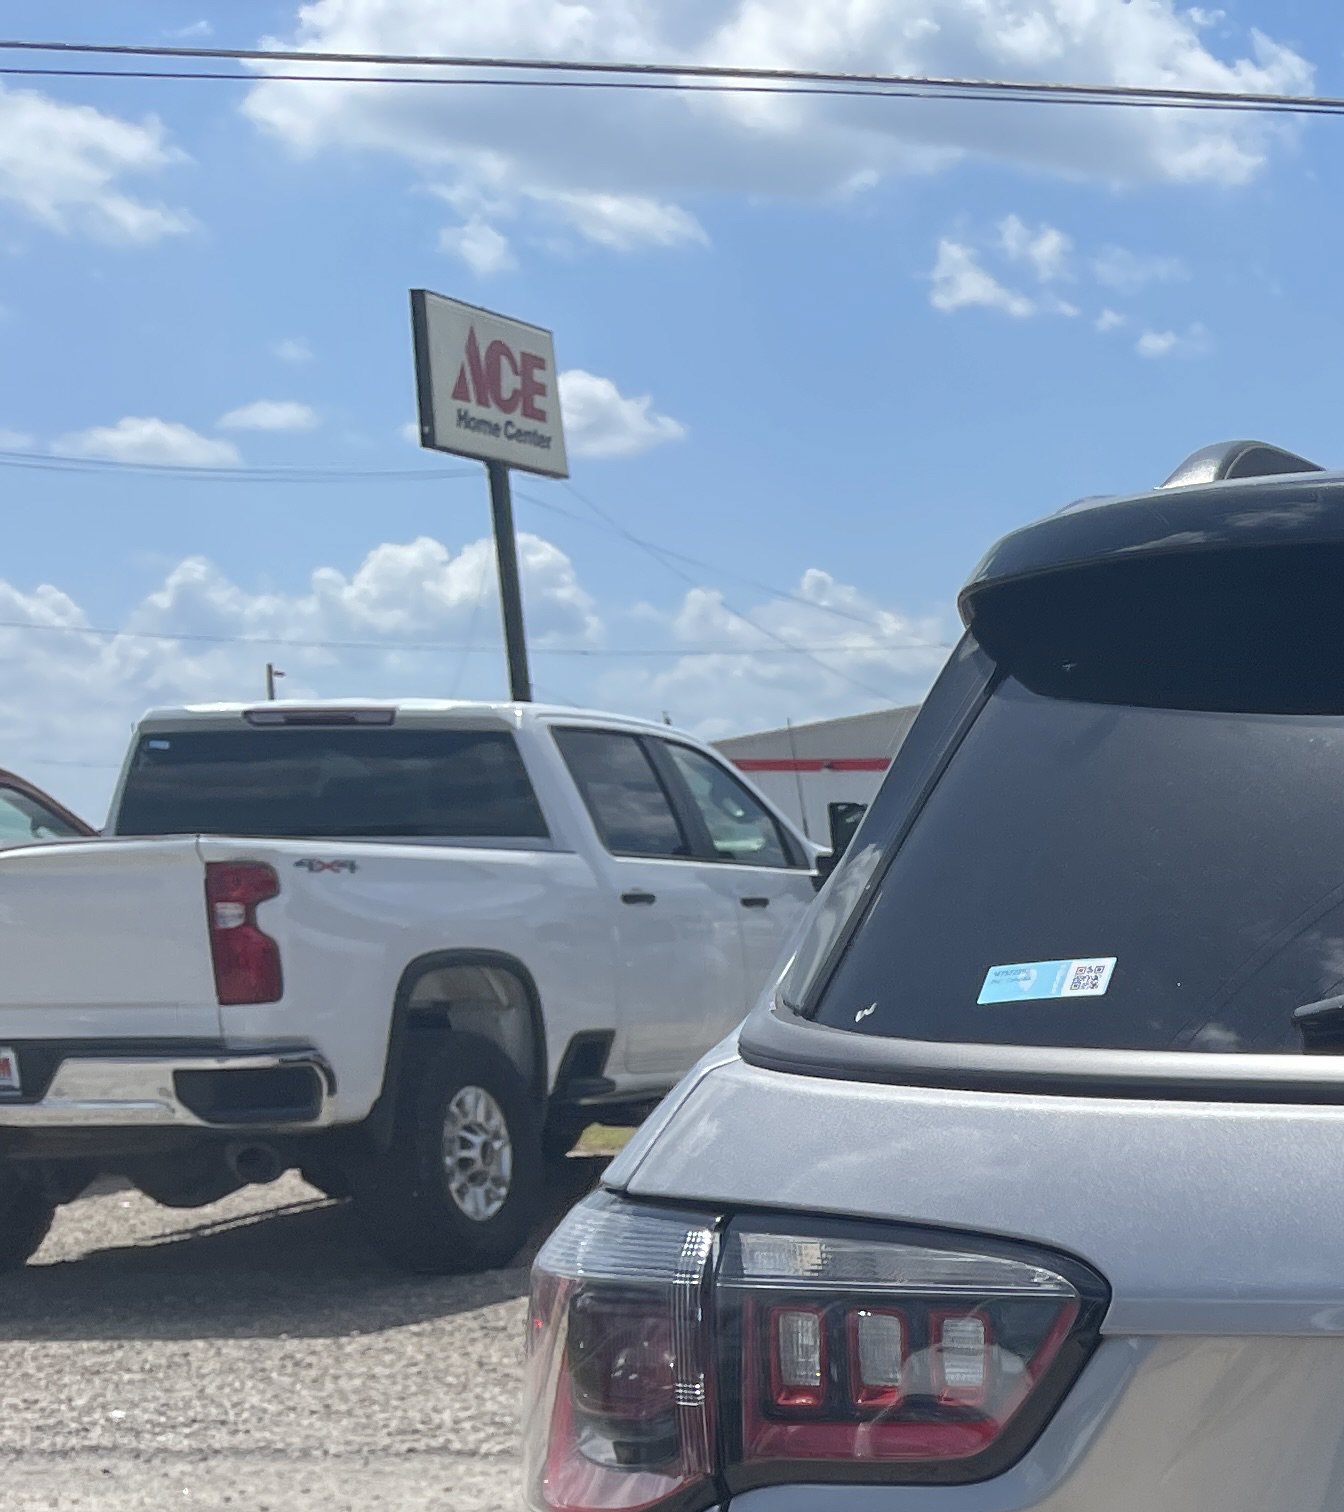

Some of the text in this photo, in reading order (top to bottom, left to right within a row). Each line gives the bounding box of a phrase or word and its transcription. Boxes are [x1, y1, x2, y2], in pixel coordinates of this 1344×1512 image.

[451, 326, 547, 423] ACE
[456, 408, 552, 449] Home Center
